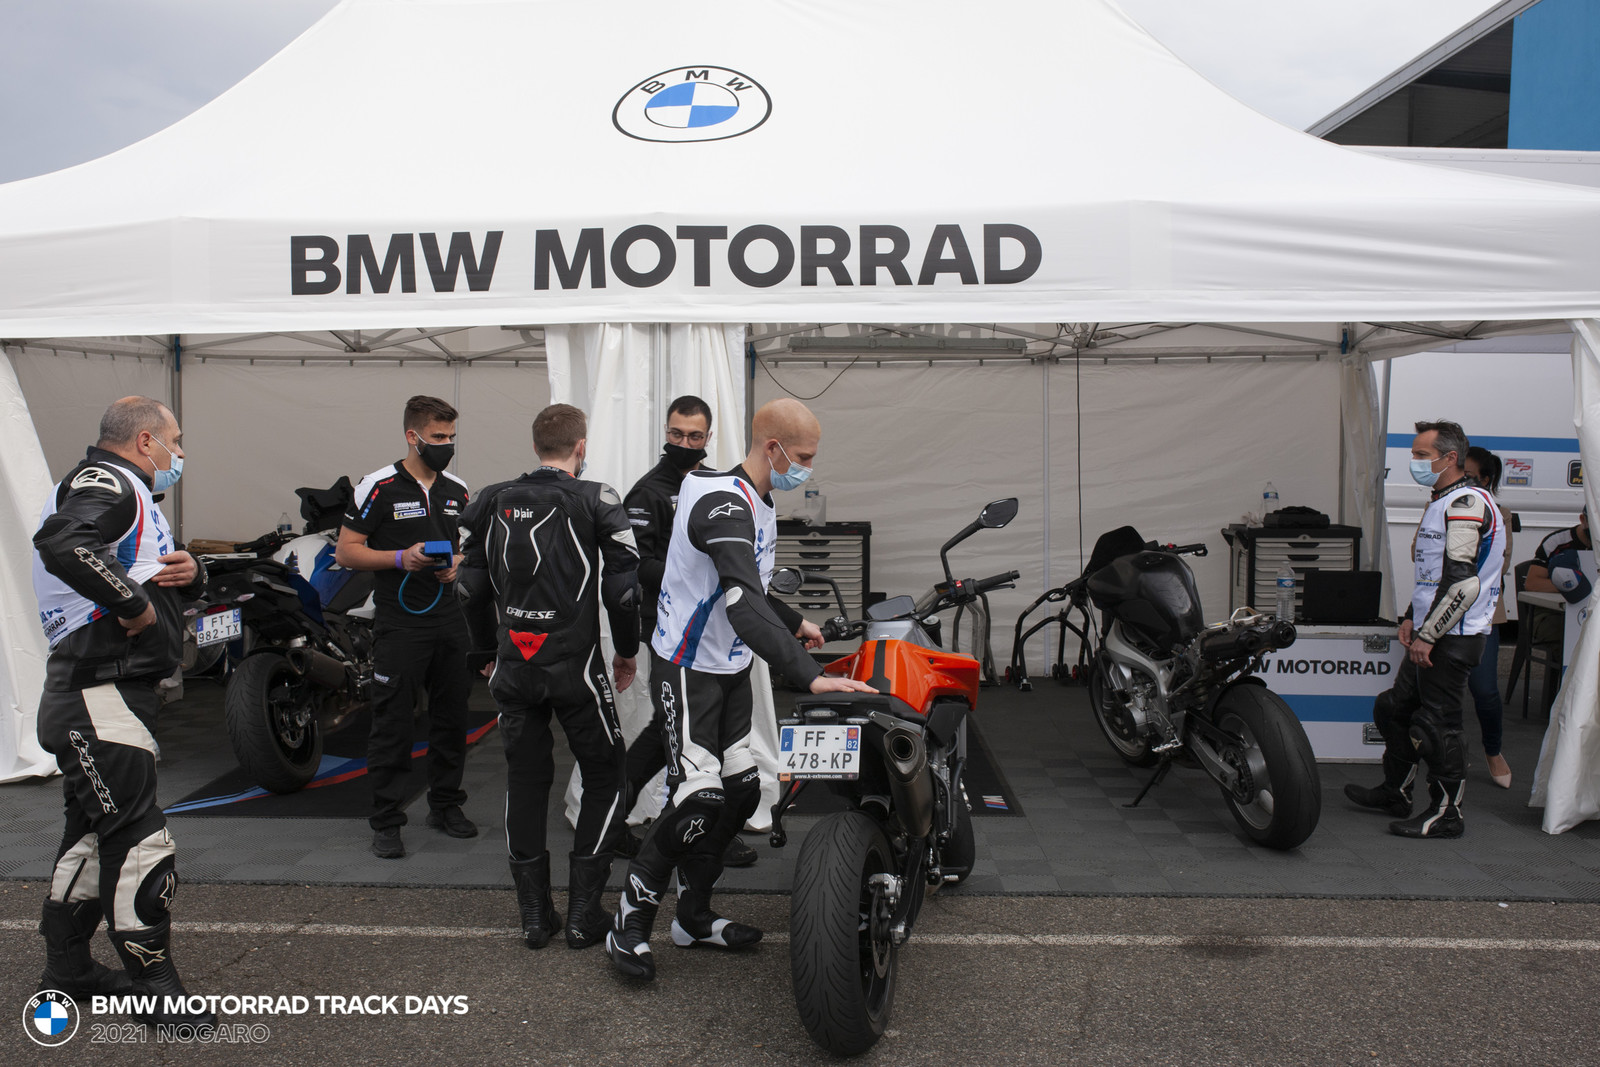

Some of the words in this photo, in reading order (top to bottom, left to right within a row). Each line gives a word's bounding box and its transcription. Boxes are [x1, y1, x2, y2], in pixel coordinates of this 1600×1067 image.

[640, 69, 752, 94] BMW
[290, 230, 504, 296] BMW
[533, 223, 1043, 291] MOTORRAD
[506, 605, 557, 620] DAINESE
[1433, 589, 1466, 634] DAINESE
[198, 623, 240, 643] 982-TX
[1276, 659, 1392, 676] MOTORRAD
[847, 740, 859, 750] 82
[786, 752, 853, 770] 478-KP
